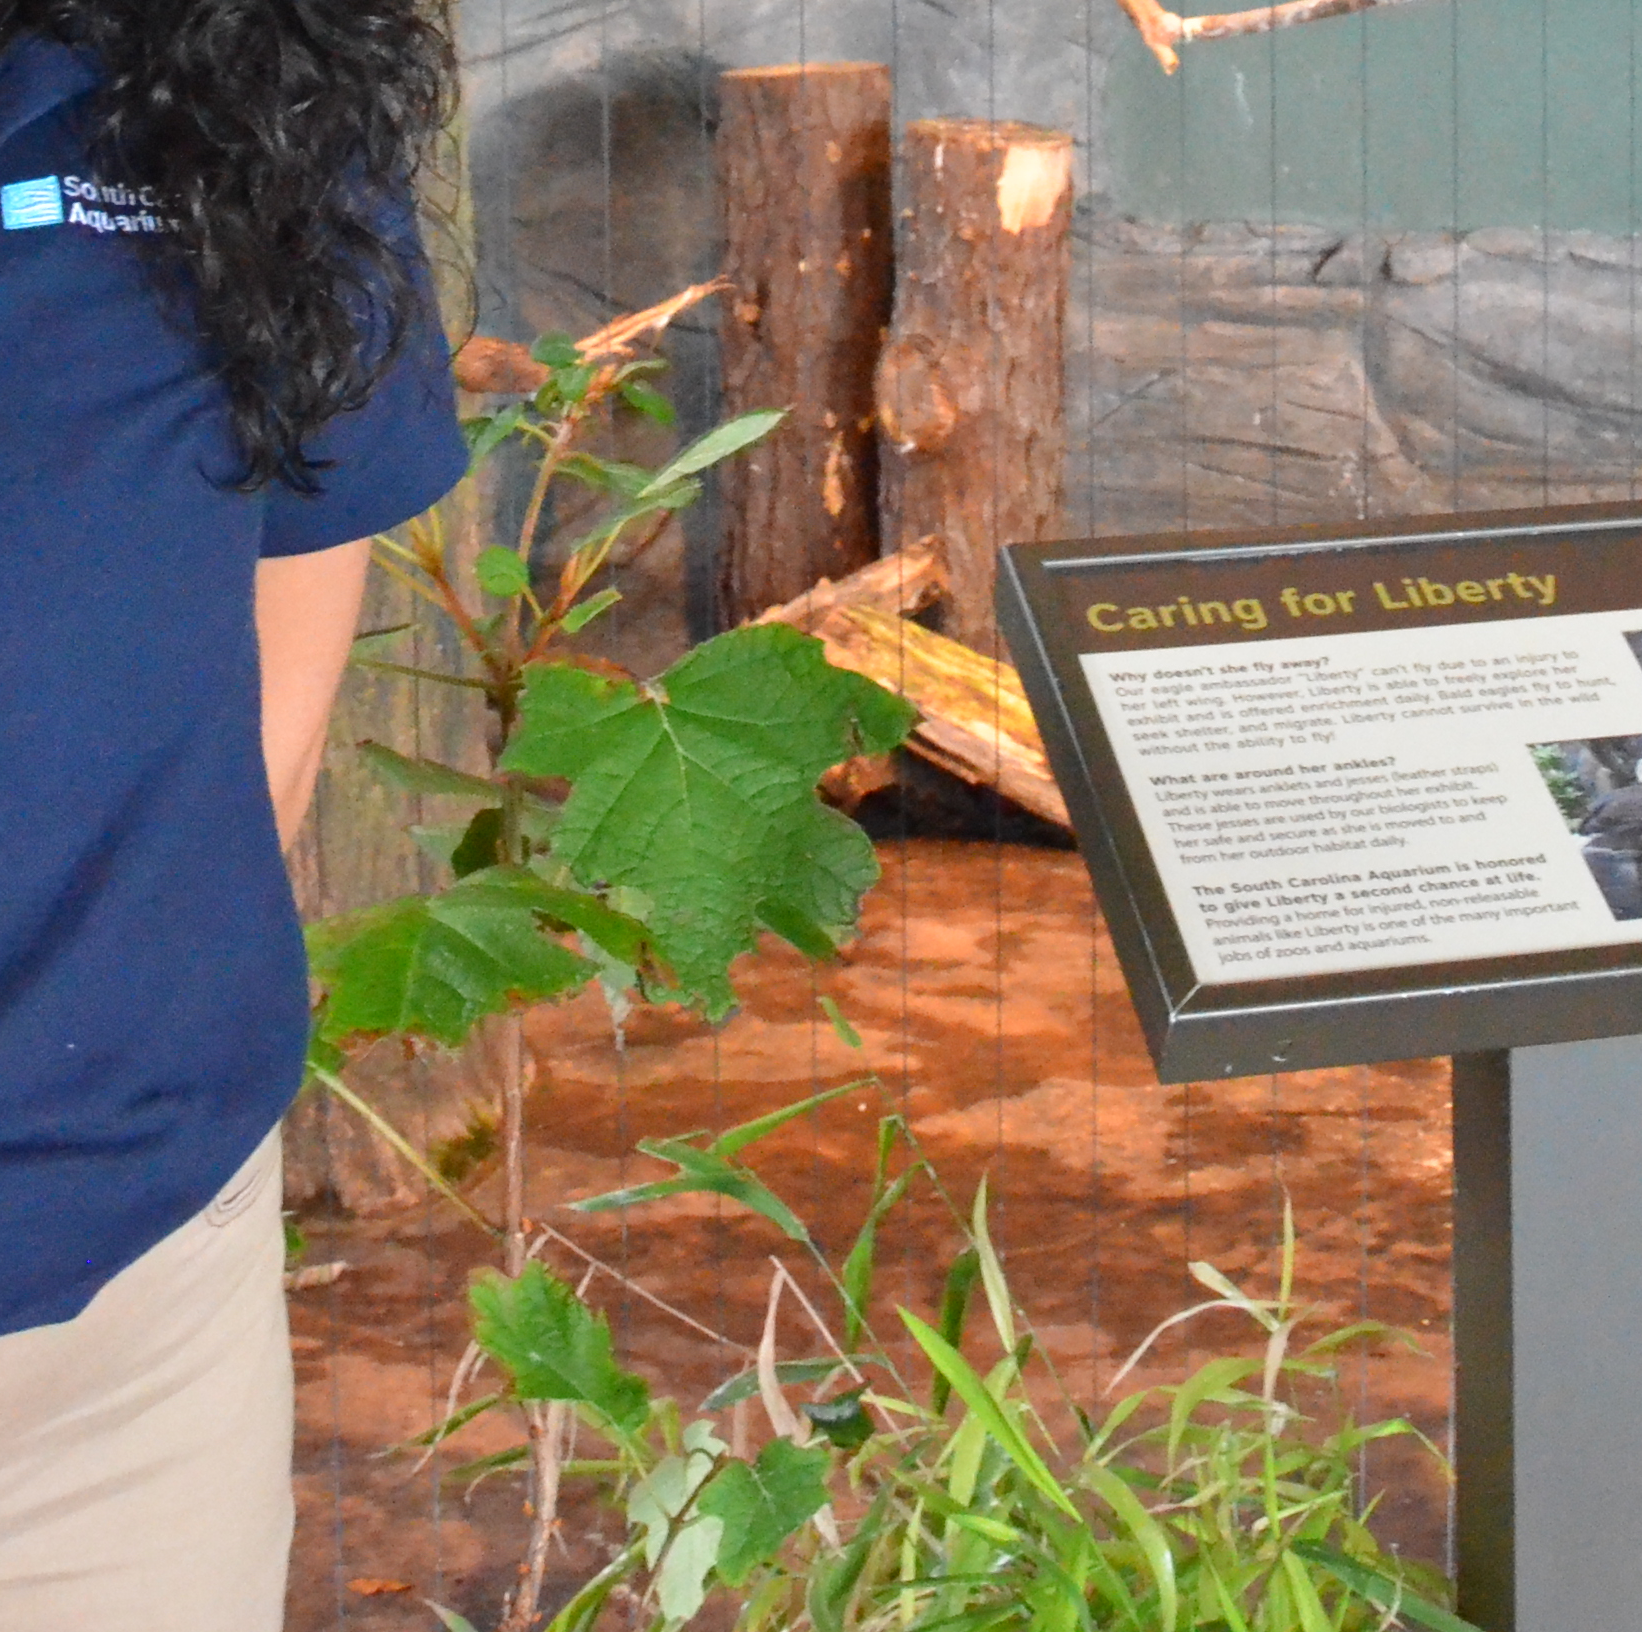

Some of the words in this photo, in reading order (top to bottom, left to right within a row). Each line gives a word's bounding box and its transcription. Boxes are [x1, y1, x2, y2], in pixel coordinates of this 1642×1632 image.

[1086, 595, 1268, 632] Caring
[1280, 586, 1356, 618] for
[1372, 571, 1557, 611] Liberty
[1108, 671, 1146, 683] Why
[1219, 664, 1247, 674] she
[1251, 661, 1274, 672] fly
[1280, 656, 1329, 669] away?
[1114, 687, 1143, 697] Our
[1150, 683, 1194, 695] eagle
[1199, 675, 1291, 691] ambassador
[1412, 662, 1431, 674] fly
[1437, 660, 1465, 670] due
[1469, 658, 1487, 667] to
[1492, 657, 1510, 665] an
[1514, 652, 1557, 664] injury
[1561, 650, 1579, 659] to
[1119, 702, 1146, 711] her
[1152, 698, 1179, 709] left
[1307, 684, 1361, 697] Liberty
[1366, 683, 1380, 691] is
[1385, 679, 1418, 689] able
[1422, 677, 1439, 686] to
[1443, 672, 1486, 684] freely
[1491, 668, 1547, 681] explore
[1551, 665, 1576, 674] her
[1126, 713, 1180, 726] exhibit
[1185, 710, 1215, 722] and
[1219, 710, 1234, 719] is
[1238, 704, 1295, 717] offered
[1299, 696, 1389, 712] enrichment
[1436, 688, 1473, 700] Bald
[1477, 684, 1528, 697] eagles
[1531, 681, 1550, 693] fly
[1554, 680, 1572, 689] to
[1132, 730, 1169, 741] seek
[1238, 721, 1268, 733] and
[1340, 711, 1395, 724] Liberty
[1400, 705, 1455, 718] cannot
[1458, 701, 1513, 713] survive
[1517, 698, 1533, 707] in
[1536, 696, 1563, 706] the
[1567, 691, 1600, 703] wild
[1138, 742, 1199, 756] without
[1203, 741, 1230, 751] the
[1236, 736, 1284, 748] ability
[1288, 734, 1307, 743] to
[1148, 774, 1196, 786] What
[1201, 772, 1228, 782] are
[1234, 765, 1294, 779] around
[1297, 764, 1326, 773] her
[1333, 755, 1395, 770] ankles?
[1154, 789, 1208, 802] Liberty
[1211, 786, 1255, 796] wears
[1259, 781, 1311, 793] anklets
[1314, 776, 1343, 788] and
[1345, 774, 1389, 788] jesses
[1390, 768, 1446, 781] (leather
[1450, 762, 1499, 776] straps)
[1162, 805, 1191, 817] and
[1193, 805, 1206, 814] is
[1210, 801, 1240, 813] able
[1243, 801, 1261, 810] to
[1263, 797, 1305, 808] move
[1307, 788, 1394, 805] throughout
[1395, 786, 1420, 796] her
[1167, 821, 1212, 832] These
[1215, 817, 1260, 831] jesses
[1263, 815, 1285, 825] are
[1288, 810, 1326, 822] used
[1326, 809, 1346, 820] by
[1349, 807, 1374, 817] our
[1377, 799, 1450, 814] biologists
[1451, 797, 1469, 807] to
[1470, 794, 1507, 805] keep
[1172, 838, 1198, 848] her
[1202, 834, 1232, 846] safe
[1236, 831, 1265, 843] and
[1268, 828, 1317, 840] secure
[1321, 826, 1337, 836] as
[1340, 823, 1366, 834] she
[1368, 822, 1382, 831] is
[1384, 815, 1436, 829] moved
[1437, 815, 1455, 824] to
[1458, 810, 1486, 823] and
[1179, 853, 1217, 864] from
[1218, 851, 1244, 860] her
[1248, 845, 1309, 859] outdoor
[1312, 839, 1367, 852] habitat
[1191, 885, 1225, 896] The
[1229, 879, 1283, 893] South
[1287, 873, 1362, 888] Carolina
[1368, 864, 1451, 881] Aquarium
[1454, 861, 1471, 871] is
[1474, 852, 1547, 869] honored
[1198, 902, 1218, 913] to
[1223, 899, 1261, 913] give
[1265, 892, 1328, 907] Liberty
[1334, 891, 1345, 900] a
[1350, 883, 1413, 899] second
[1417, 878, 1479, 892] chance
[1485, 874, 1502, 885] at
[1204, 914, 1281, 928] Providing
[1283, 913, 1292, 922] a
[1293, 909, 1340, 921] home
[1342, 905, 1364, 916] for
[1428, 887, 1539, 907] non-releasable
[1212, 930, 1273, 946] animals
[1274, 928, 1302, 939] like
[1304, 923, 1359, 937] Liberty
[1362, 922, 1376, 931] is
[1377, 919, 1407, 930] one
[1410, 914, 1426, 926] of
[1428, 913, 1455, 925] the
[1457, 910, 1500, 921] many
[1502, 900, 1579, 917] important
[1217, 950, 1252, 965] jobs
[1255, 946, 1271, 959] of
[1275, 946, 1311, 958] zoos
[1314, 940, 1344, 953] and
